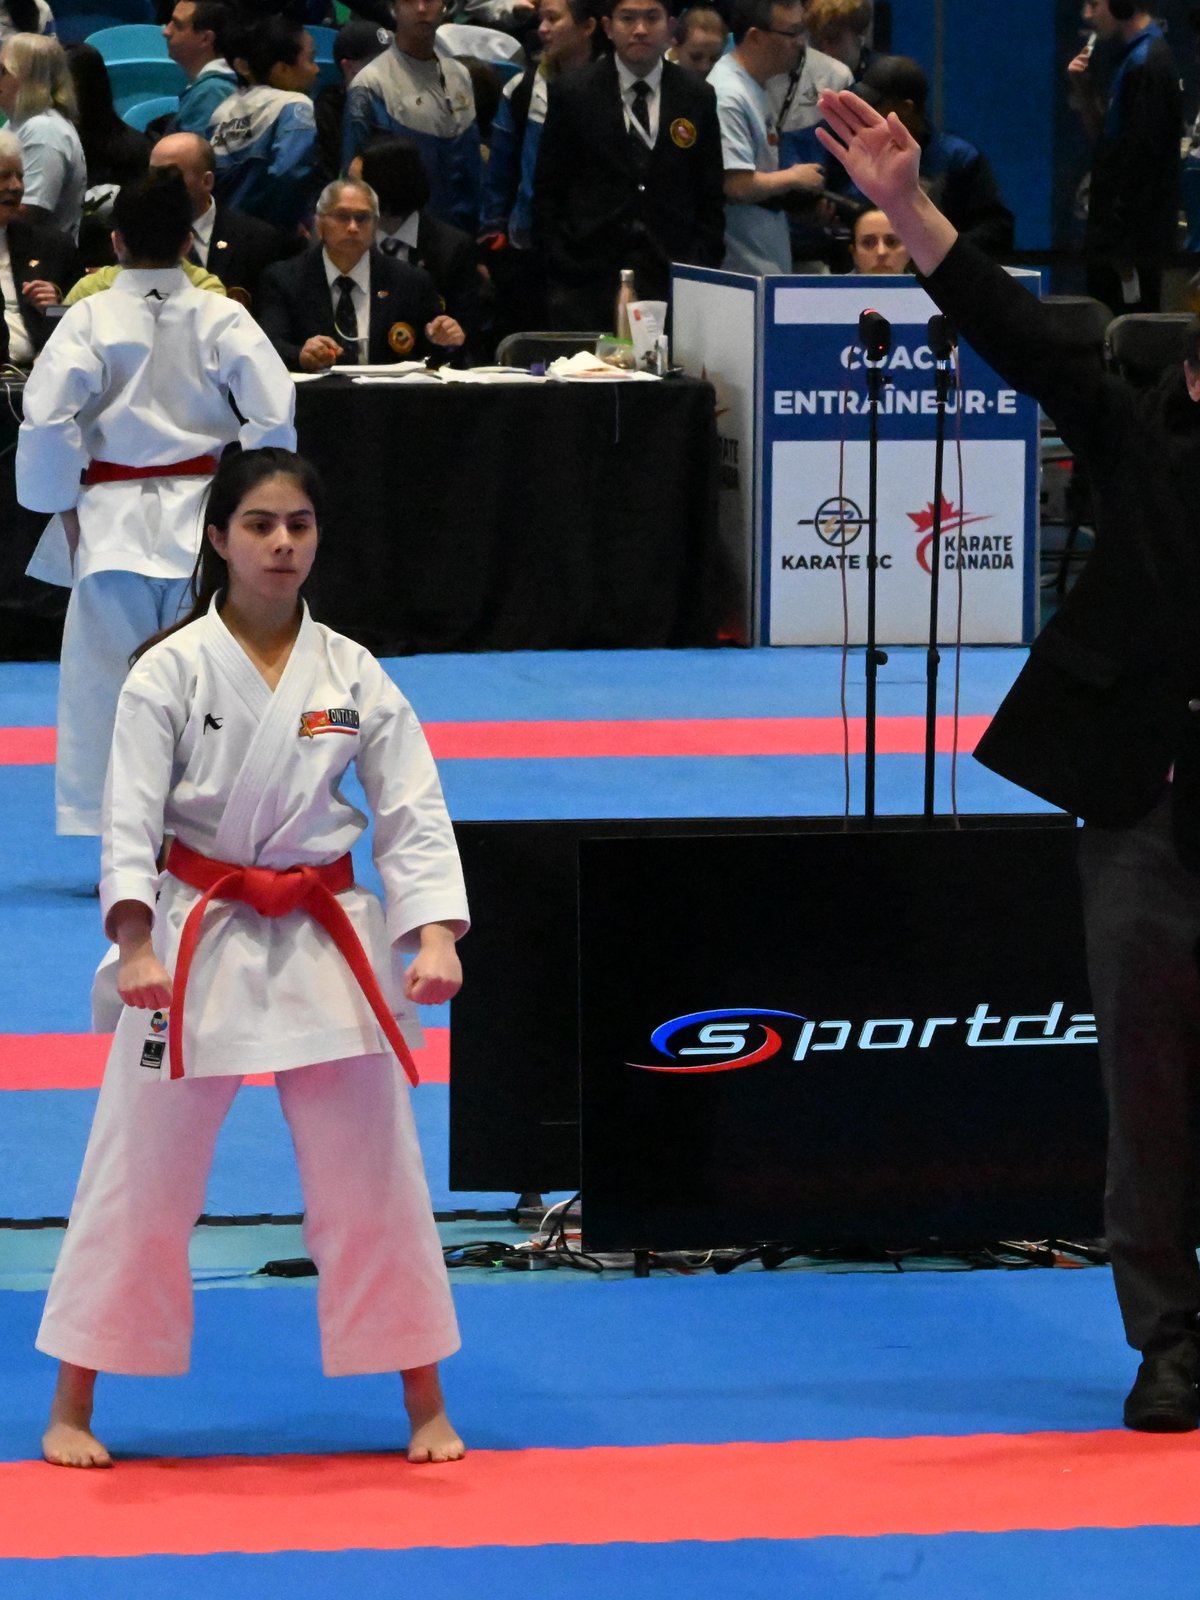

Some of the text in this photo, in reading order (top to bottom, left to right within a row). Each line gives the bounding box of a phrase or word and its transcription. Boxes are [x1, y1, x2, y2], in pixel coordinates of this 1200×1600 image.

[944, 535, 1013, 552] KARATE
[781, 555, 861, 570] KARATE
[944, 554, 1015, 570] CANADA
[330, 708, 359, 724] ONTARIO
